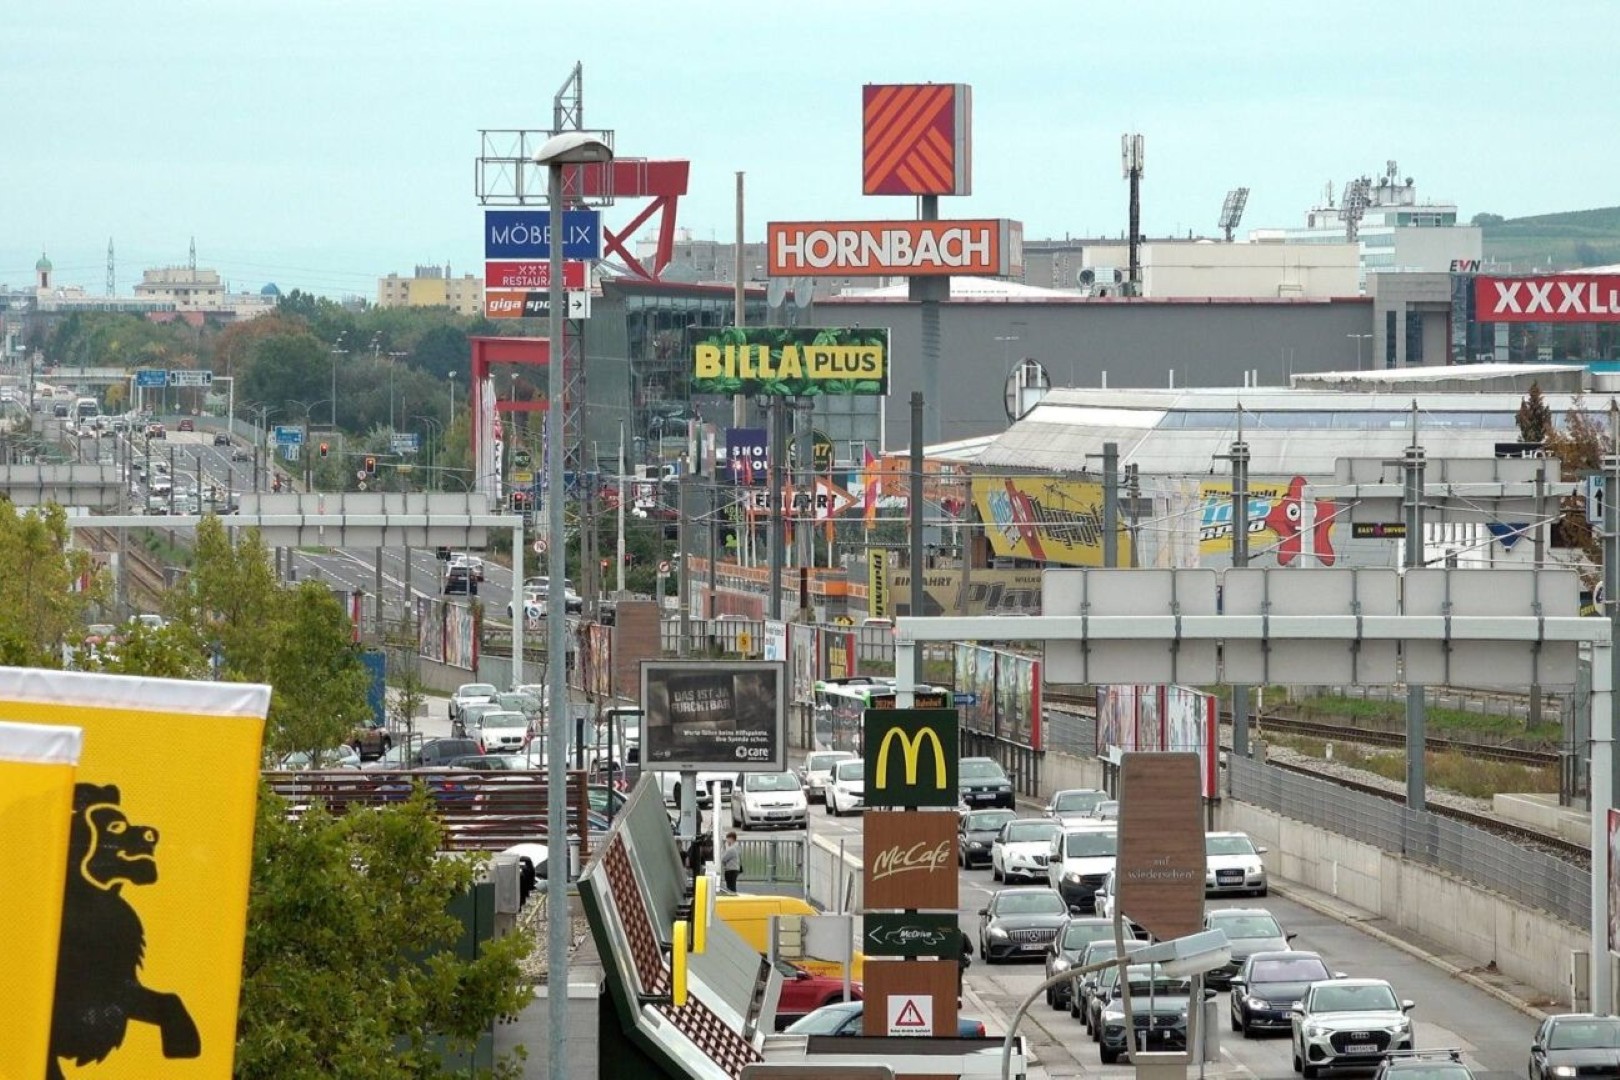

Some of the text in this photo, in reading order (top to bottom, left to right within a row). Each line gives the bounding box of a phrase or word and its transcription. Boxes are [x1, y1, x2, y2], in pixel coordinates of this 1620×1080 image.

[491, 222, 591, 245] MÖBEIX
[777, 228, 990, 268] HORNBACH
[1449, 259, 1481, 272] EVN
[489, 298, 522, 312] giga
[695, 344, 876, 379] BILLA PLUS
[747, 747, 769, 757] care
[872, 840, 951, 876] McCafé
[899, 929, 932, 938] McDrive
